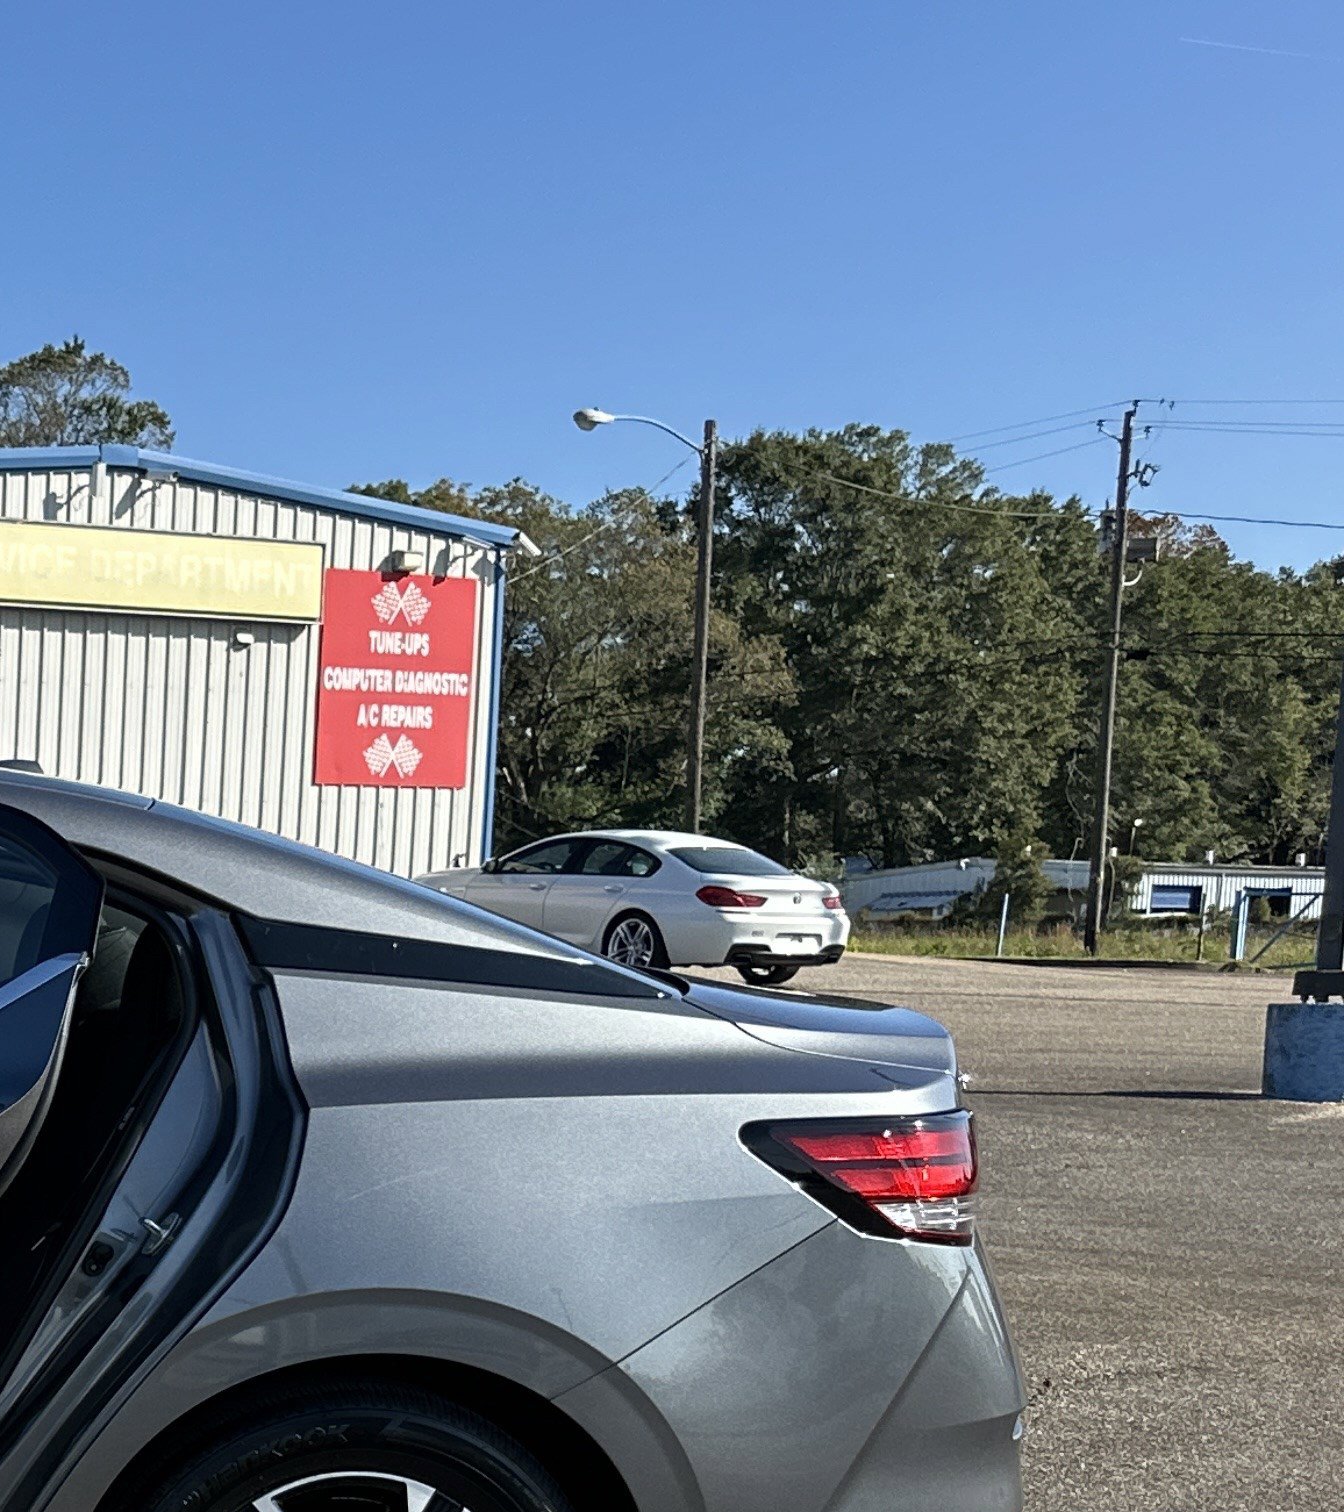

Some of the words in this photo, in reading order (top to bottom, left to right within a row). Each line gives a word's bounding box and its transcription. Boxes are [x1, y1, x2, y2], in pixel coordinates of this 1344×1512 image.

[368, 629, 430, 657] TUNE-UPS
[323, 666, 393, 693] COMPUTER
[394, 670, 469, 697] DIAGNOSTIC
[380, 704, 433, 730] REPAIRS
